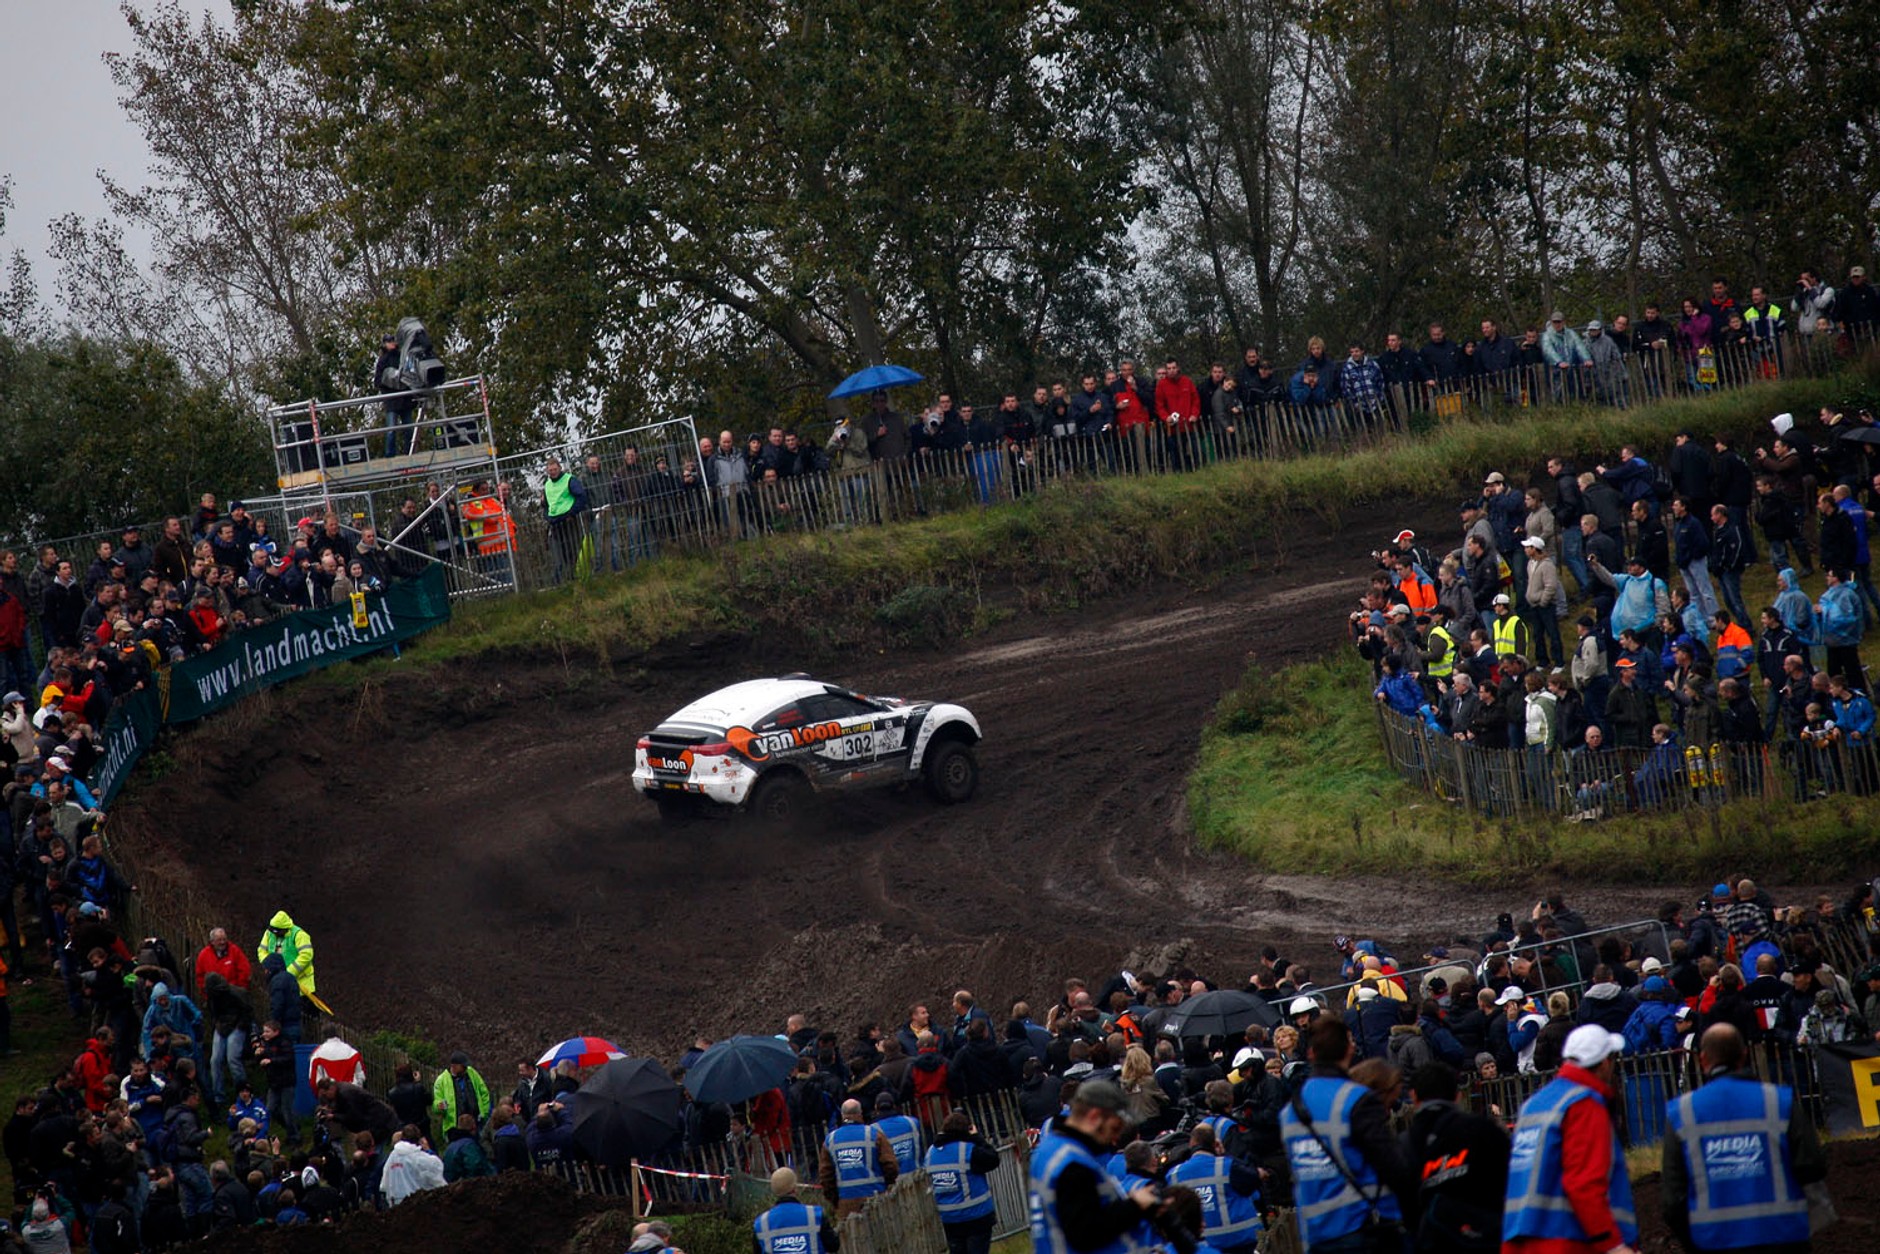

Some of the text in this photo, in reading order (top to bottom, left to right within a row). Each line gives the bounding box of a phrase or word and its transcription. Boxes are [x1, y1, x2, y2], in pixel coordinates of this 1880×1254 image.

[845, 735, 872, 756] 302
[1707, 1134, 1762, 1154] MEDIA
[837, 1148, 863, 1158] MEDIA
[931, 1172, 956, 1180] MEDIA
[1194, 1186, 1213, 1195] DIA
[774, 1235, 806, 1246] MEDIA
